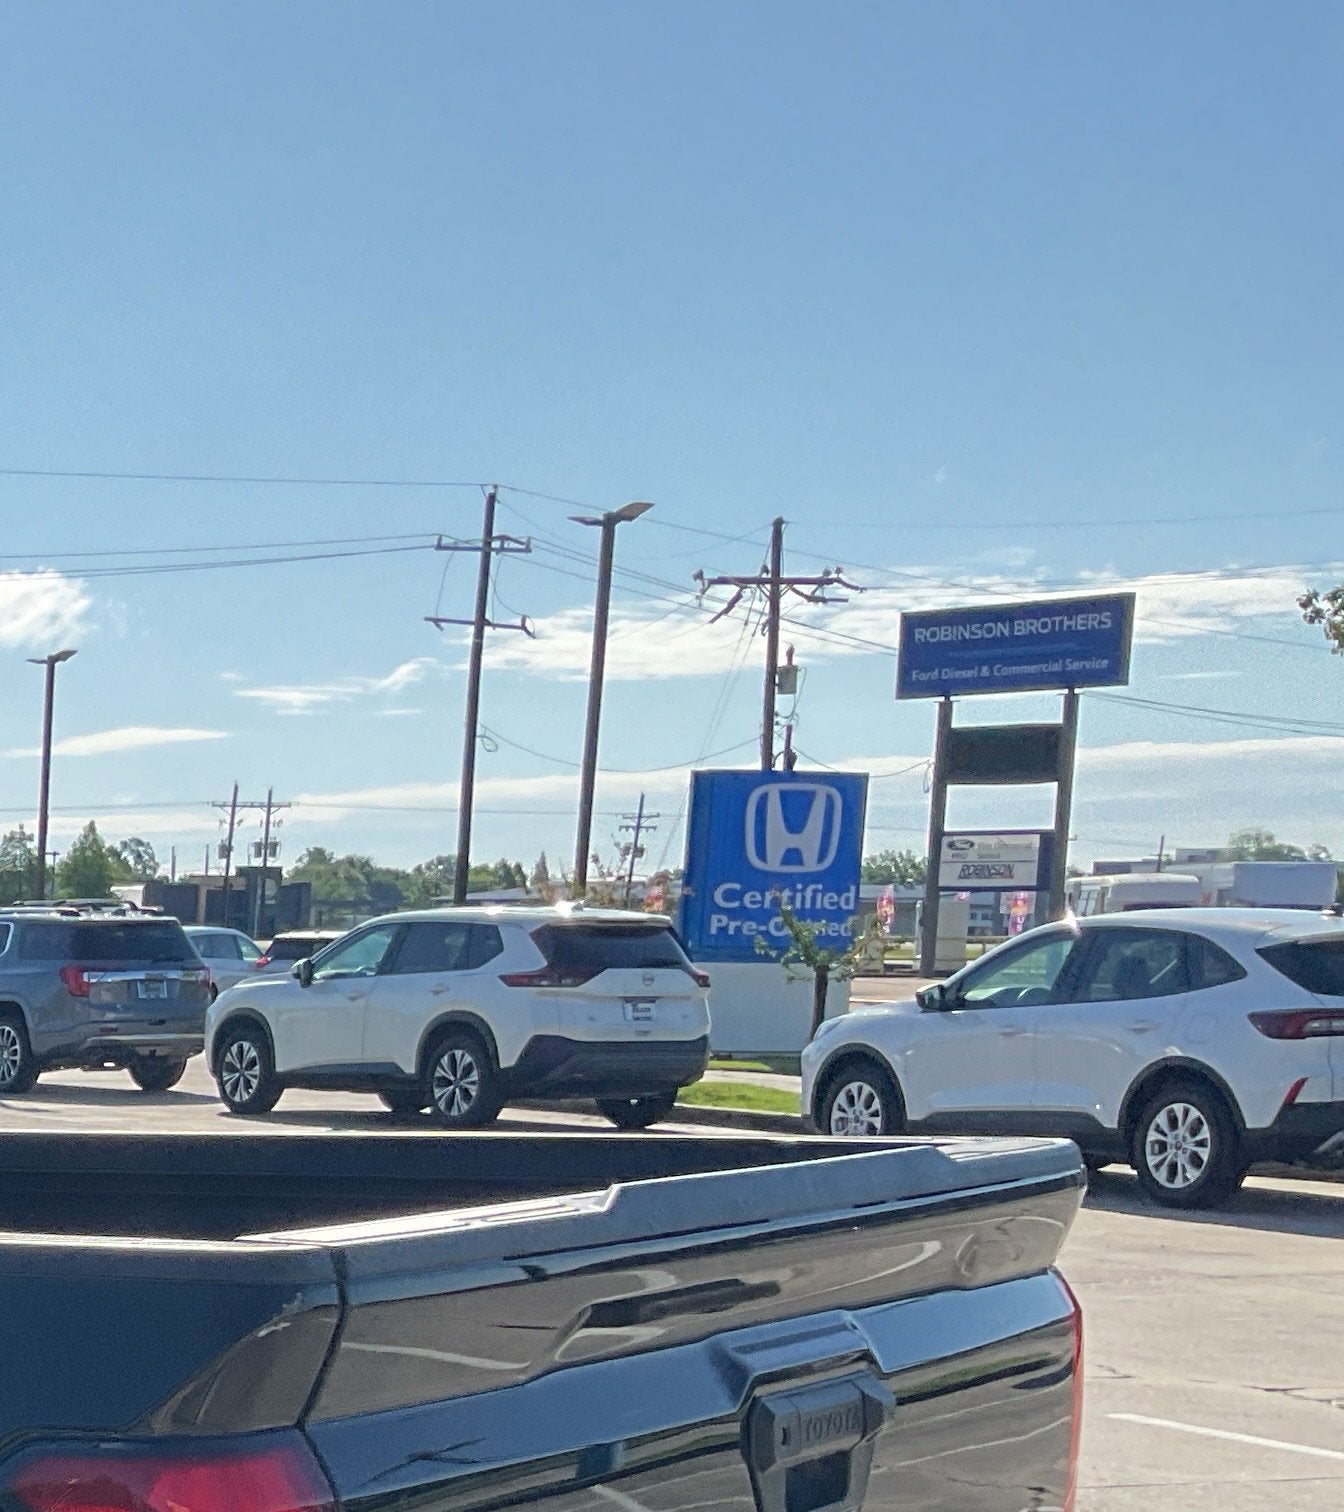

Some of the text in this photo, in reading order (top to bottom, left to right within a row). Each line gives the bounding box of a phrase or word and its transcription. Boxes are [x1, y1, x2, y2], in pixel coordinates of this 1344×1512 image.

[914, 612, 1112, 643] ROBINSON BROTHERS
[912, 658, 1109, 682] Ford Diesel & Commercial Service
[713, 883, 857, 910] Certified
[709, 914, 853, 937] Pre-Oned
[806, 1406, 861, 1443] TOYOTA
